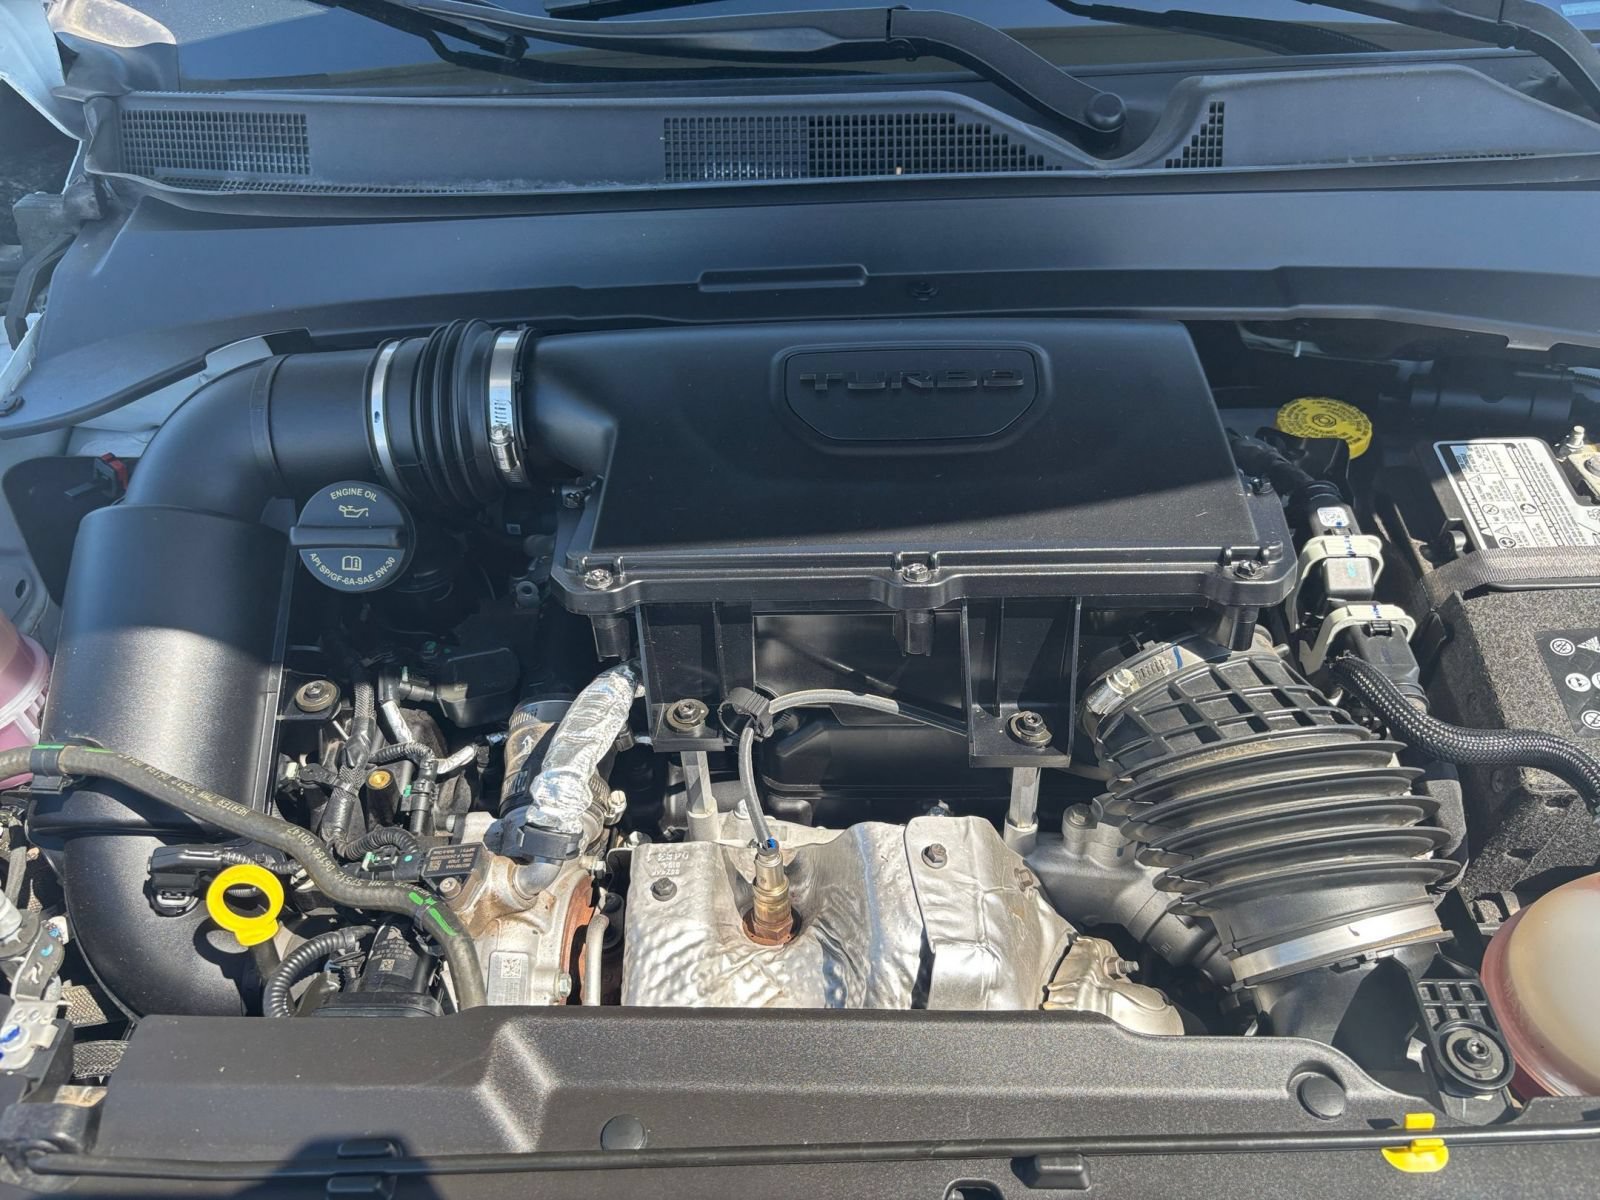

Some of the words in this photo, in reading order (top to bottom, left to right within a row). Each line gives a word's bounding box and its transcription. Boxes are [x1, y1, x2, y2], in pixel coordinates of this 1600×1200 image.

[799, 368, 1025, 391] TURBO
[330, 487, 363, 500] ENGINE
[364, 490, 378, 503] OIL
[310, 552, 322, 567] API
[376, 556, 396, 578] 5W-30
[287, 827, 315, 847] 00147
[311, 847, 336, 872] 06184
